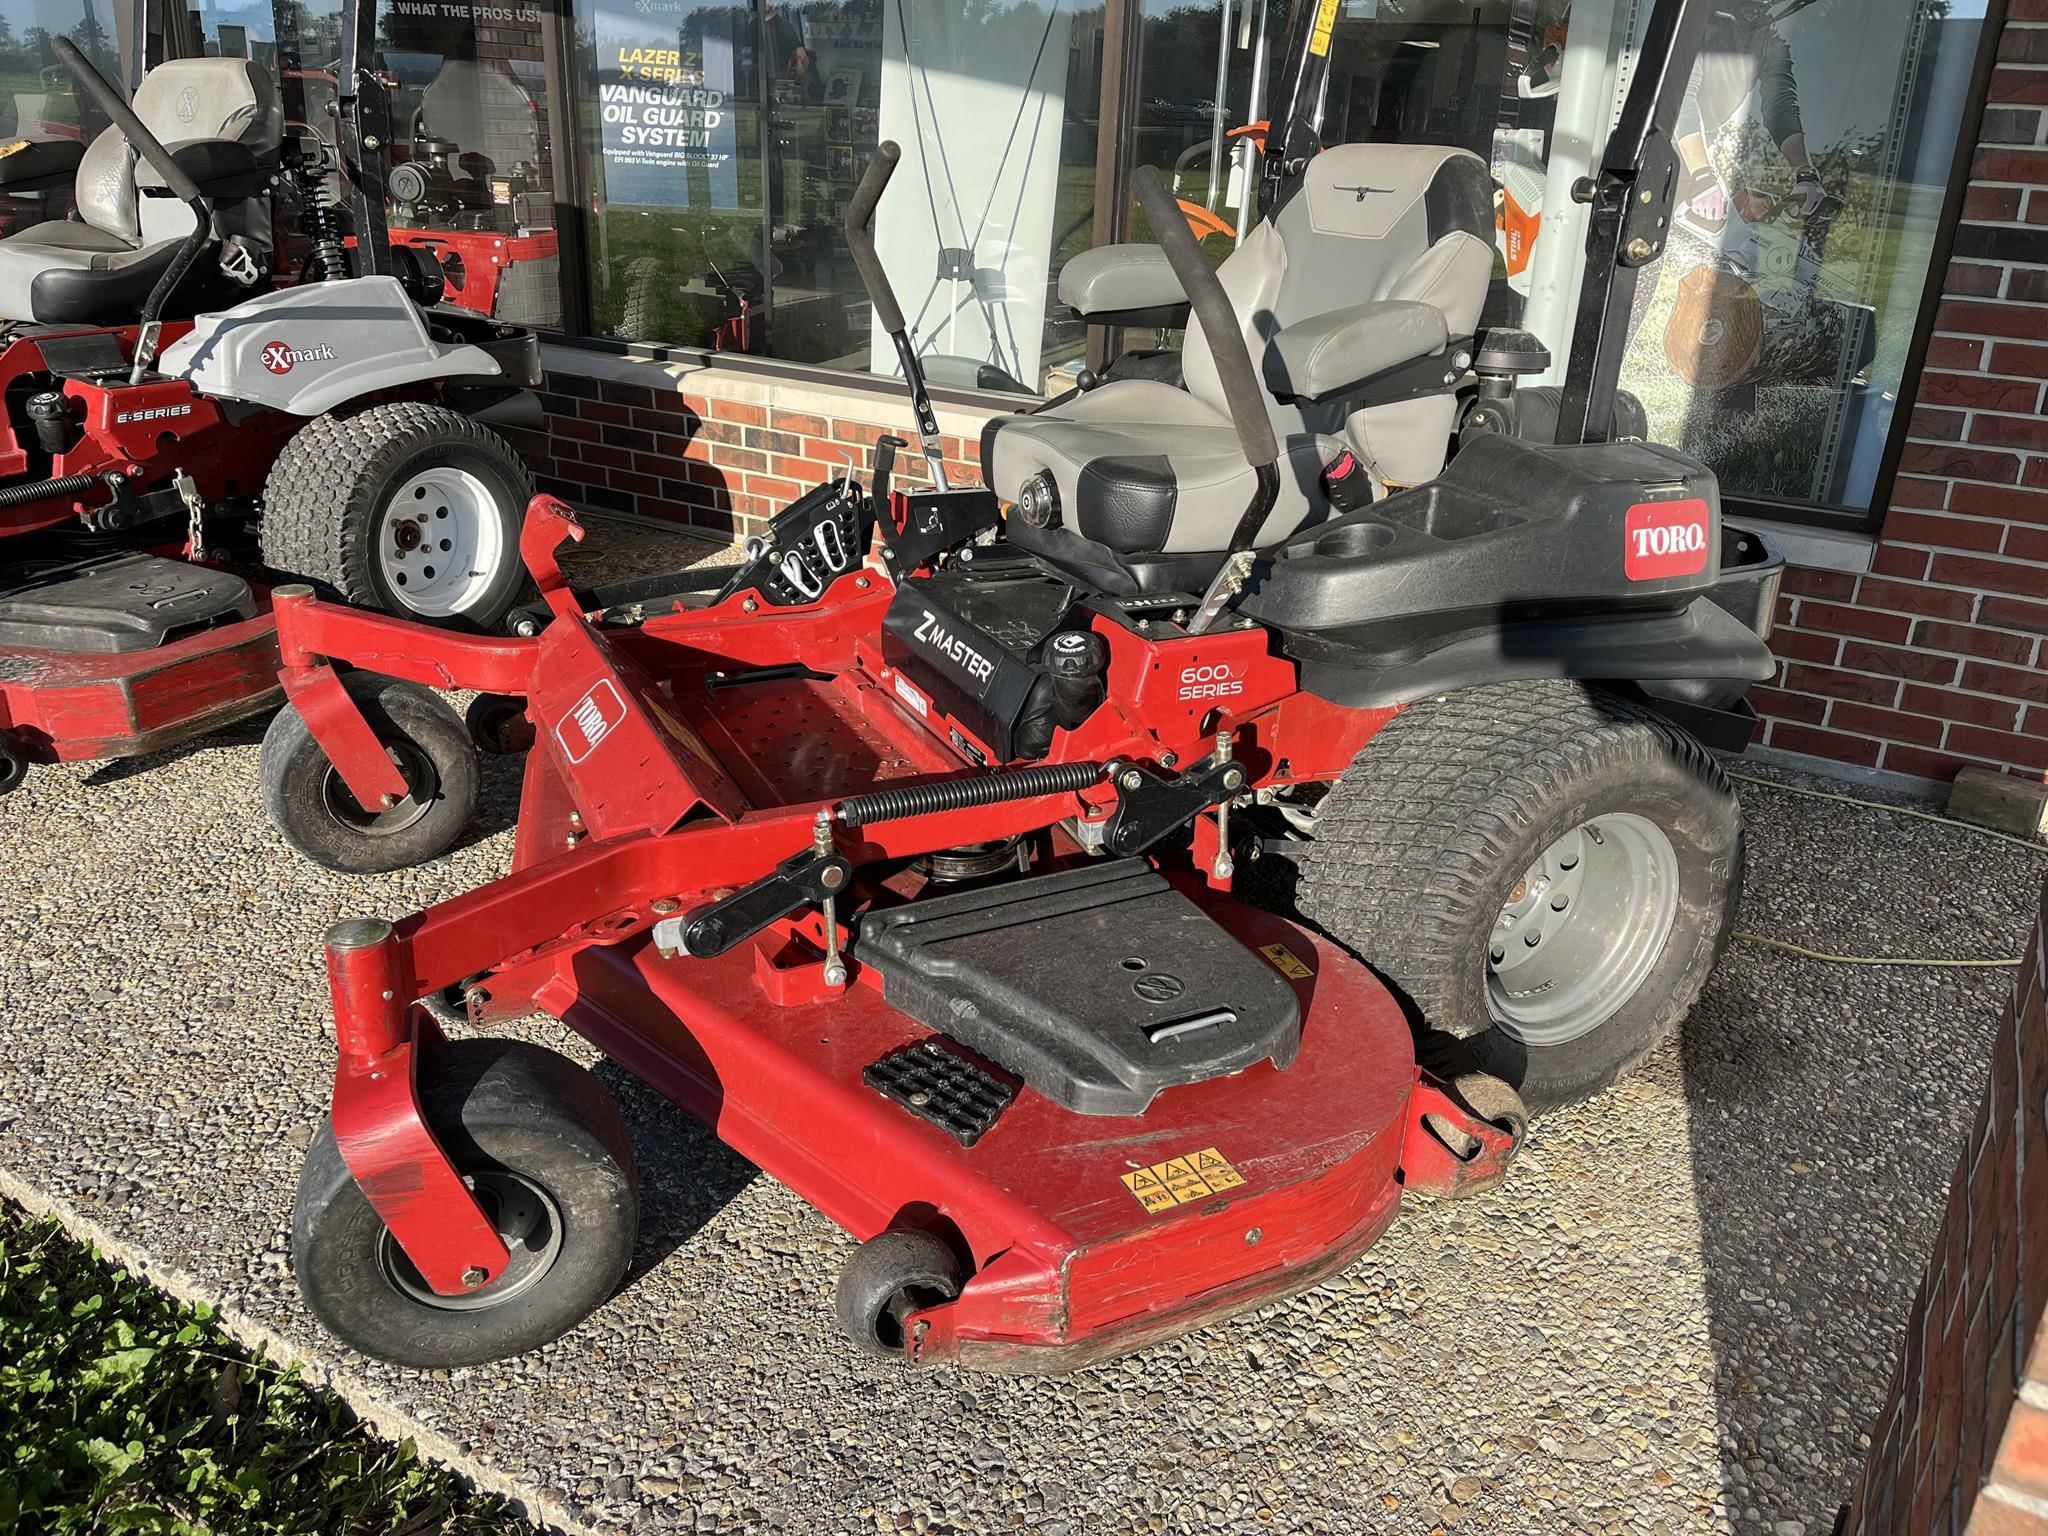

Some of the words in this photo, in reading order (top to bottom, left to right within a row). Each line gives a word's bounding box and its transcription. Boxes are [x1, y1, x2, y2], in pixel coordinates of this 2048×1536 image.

[398, 3, 438, 16] WHAT
[441, 5, 470, 18] THE
[473, 7, 513, 21] PROS
[619, 48, 680, 66] LAZER
[619, 65, 704, 85] X-SERIES
[600, 84, 723, 108] VANGUARD
[603, 105, 638, 124] OIL
[621, 126, 710, 148] SYSTEM
[603, 148, 631, 157] Equipped
[645, 151, 674, 159] Vanguard
[677, 160, 691, 168] with
[701, 161, 720, 169] Guard
[1510, 230, 1518, 262] STIHL
[1810, 273, 1835, 290] STIHL
[260, 343, 336, 370] eXmark
[1632, 523, 1704, 558] TORO
[1181, 664, 1230, 684] 600
[1179, 681, 1243, 701] SERIES
[573, 696, 608, 747] TORO
